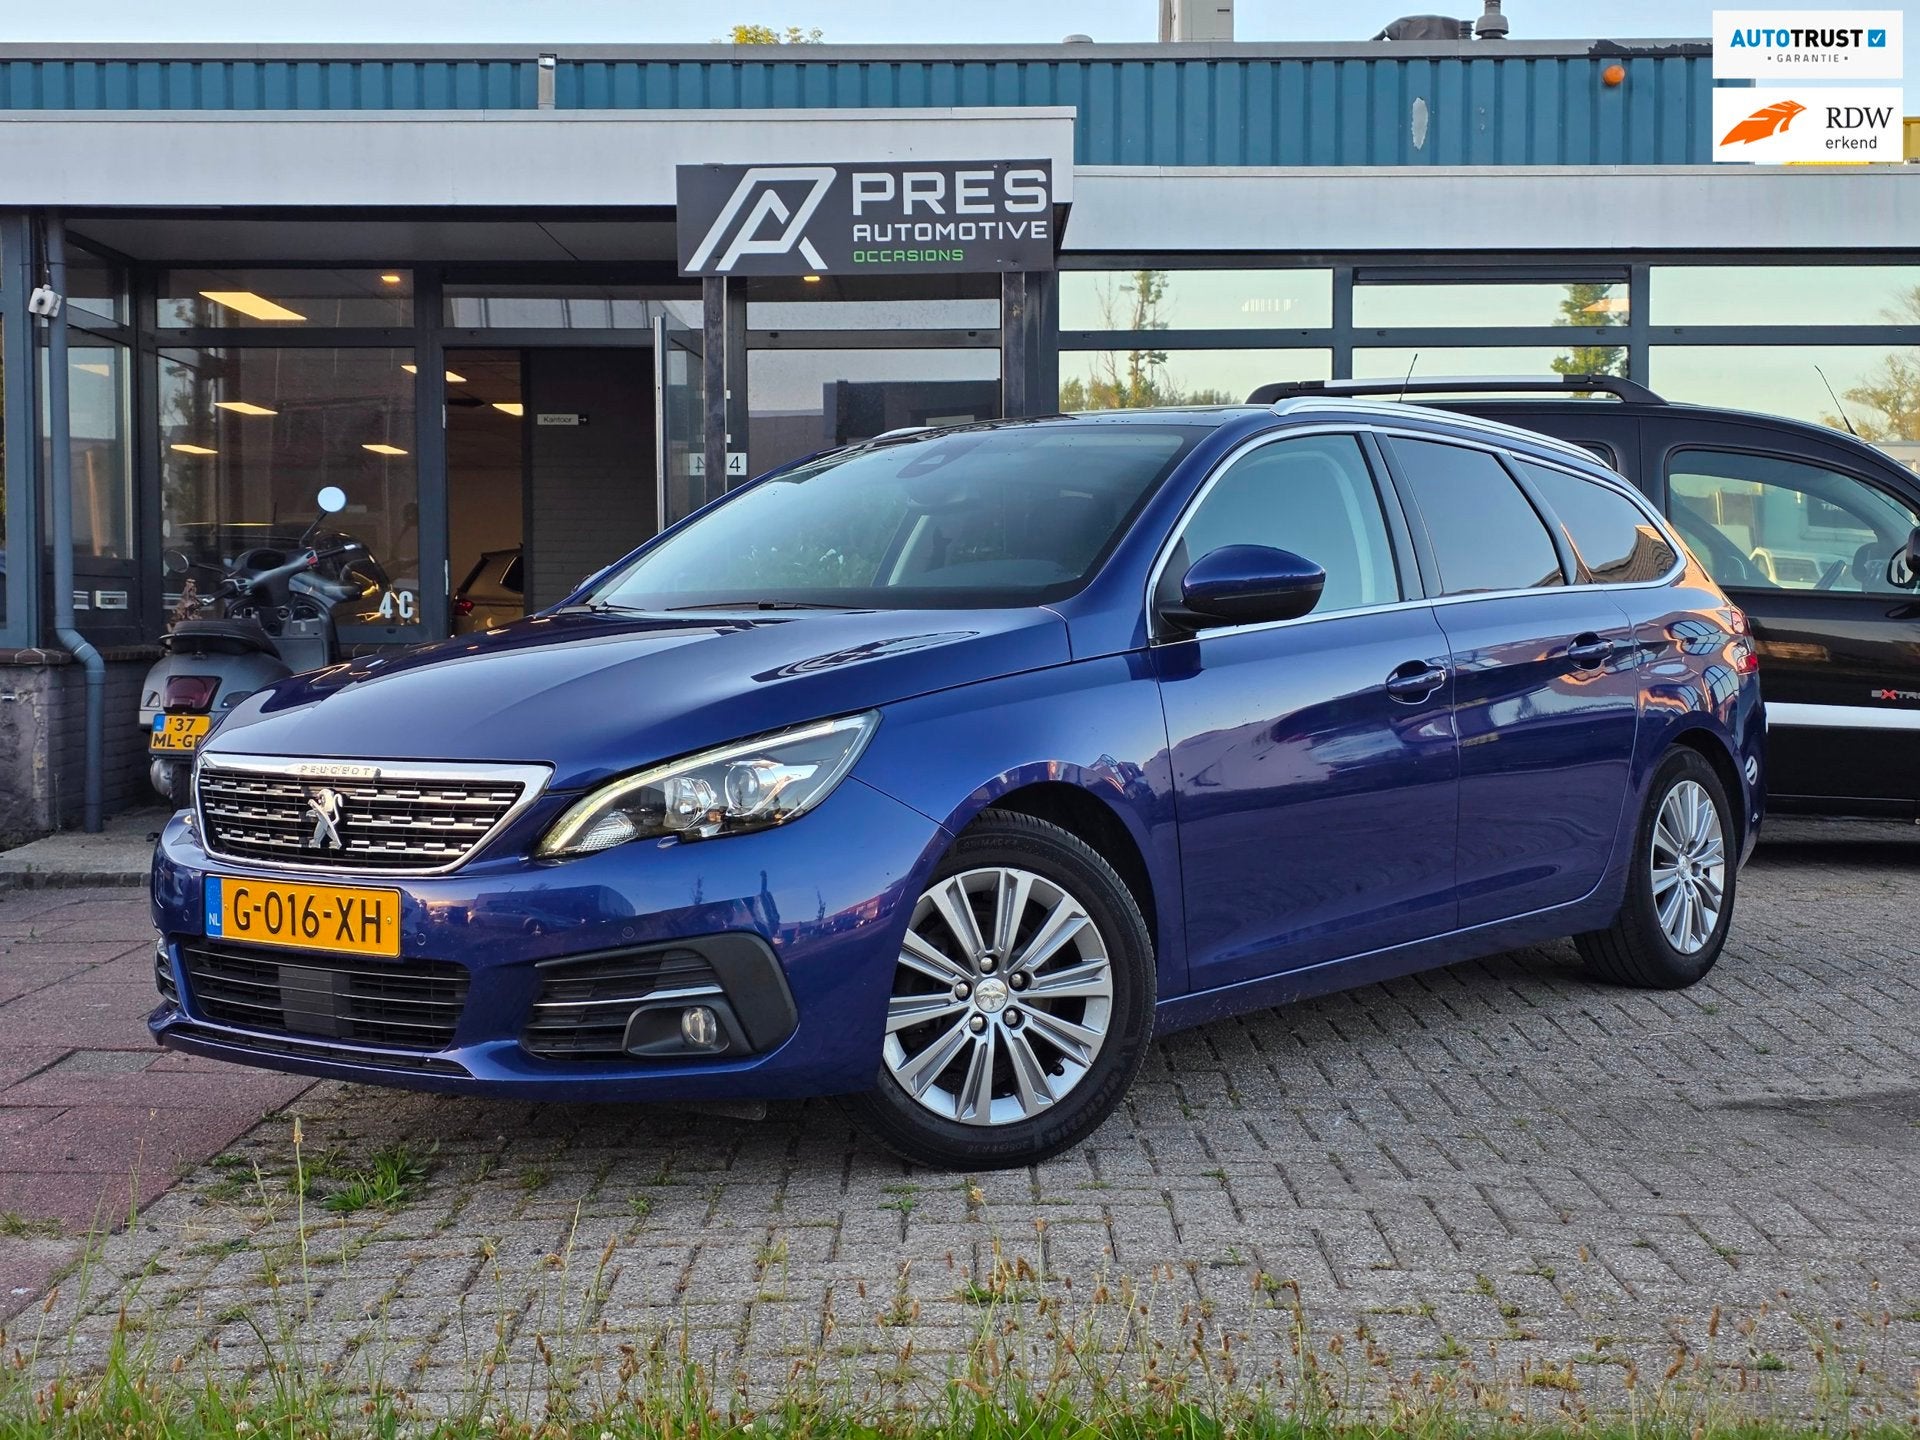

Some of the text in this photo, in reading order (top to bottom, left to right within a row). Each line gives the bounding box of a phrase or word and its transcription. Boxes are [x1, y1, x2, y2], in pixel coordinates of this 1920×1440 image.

[852, 169, 1047, 216] PRES
[853, 221, 1048, 242] AUTOMOTIVE
[853, 249, 964, 262] OCCASIONS
[543, 416, 572, 424] Kantoor
[729, 455, 741, 473] 4
[1871, 689, 1920, 700] EXTR
[174, 718, 196, 732] 37
[300, 764, 371, 776] PEUGEOT
[208, 913, 221, 927] NL
[233, 888, 382, 944] G-016-XH
